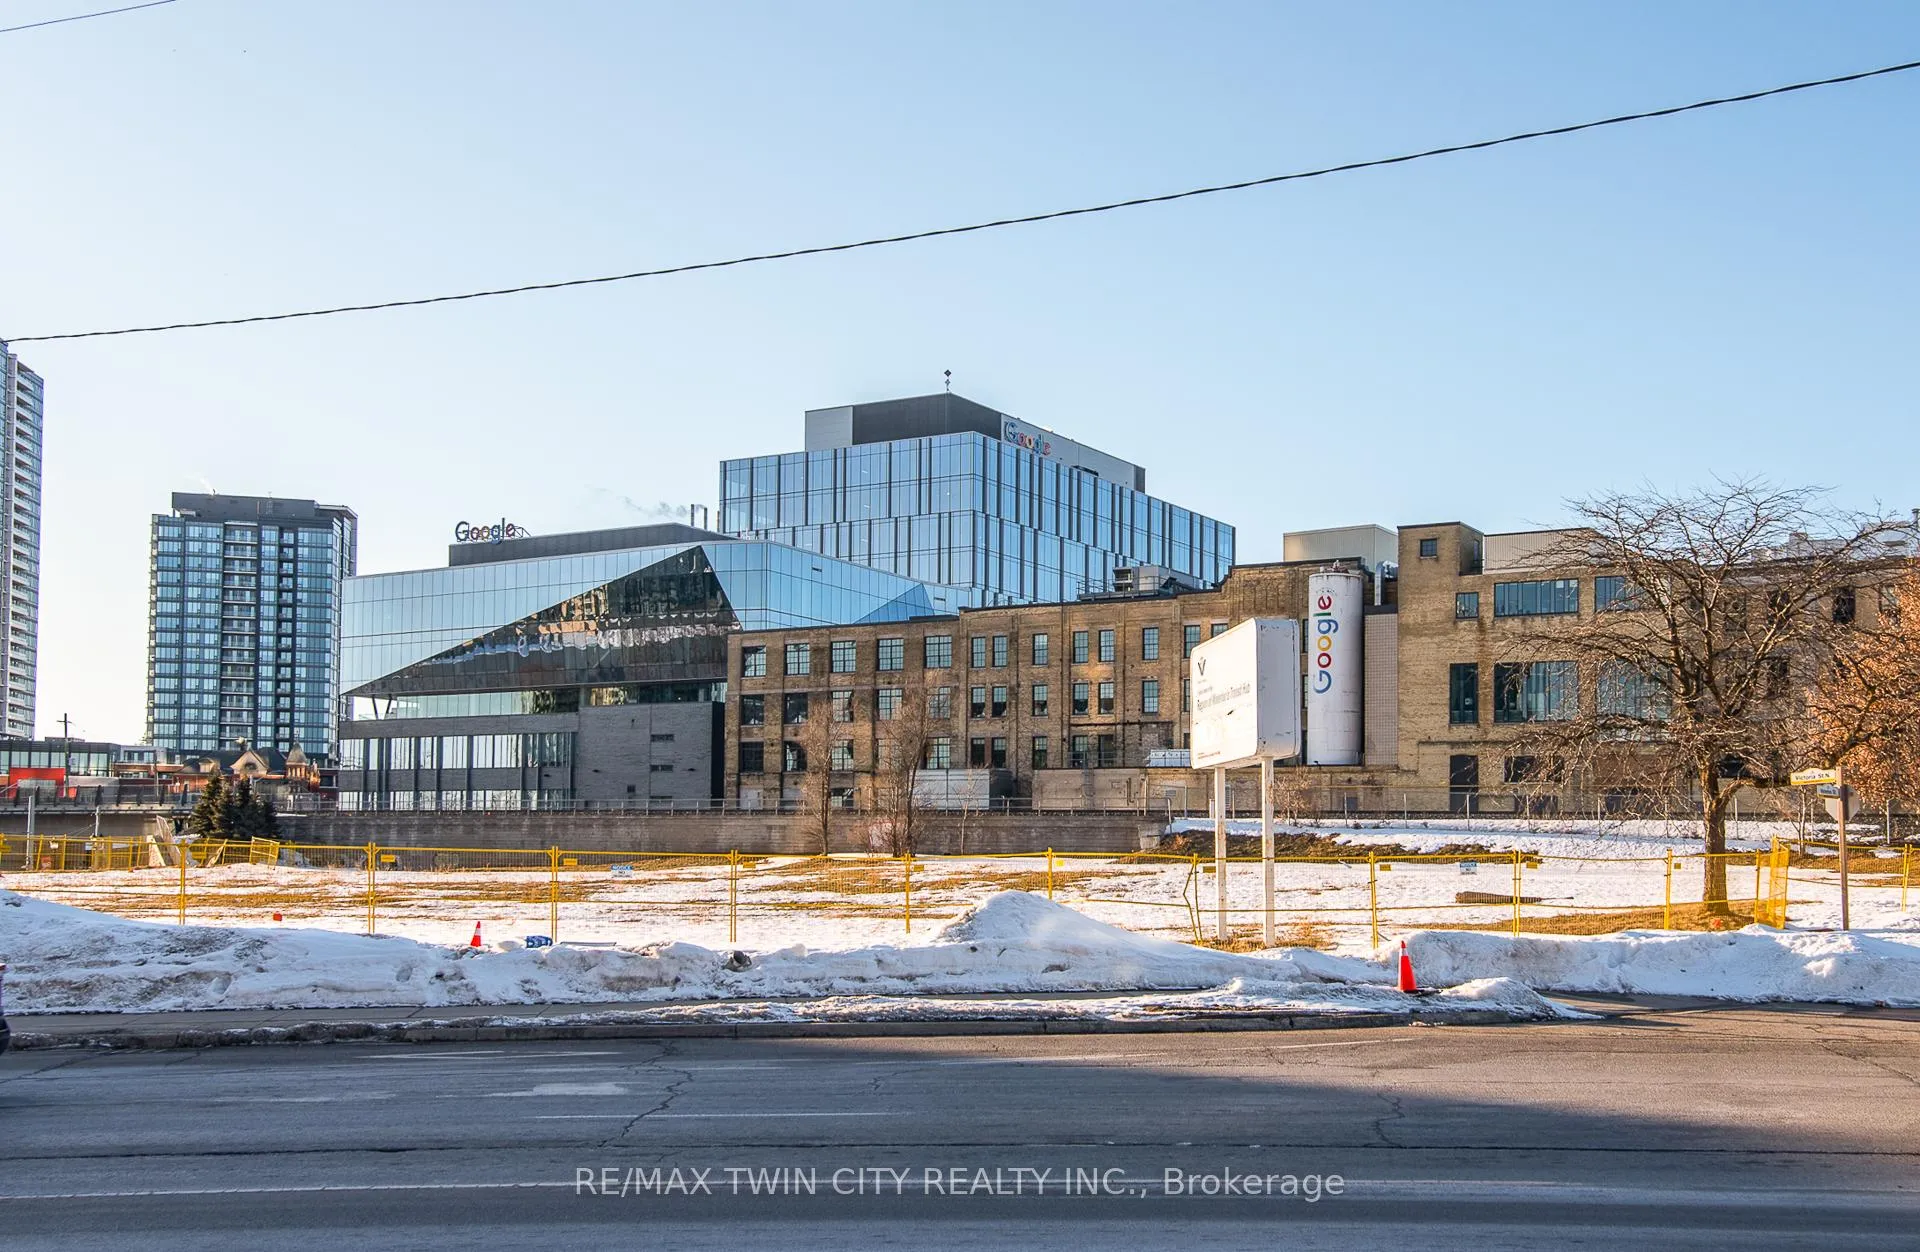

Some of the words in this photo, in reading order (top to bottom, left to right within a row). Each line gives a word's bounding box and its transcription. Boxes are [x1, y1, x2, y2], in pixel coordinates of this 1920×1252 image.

[1004, 421, 1051, 456] Google
[455, 517, 515, 544] Google
[1312, 595, 1339, 694] Google
